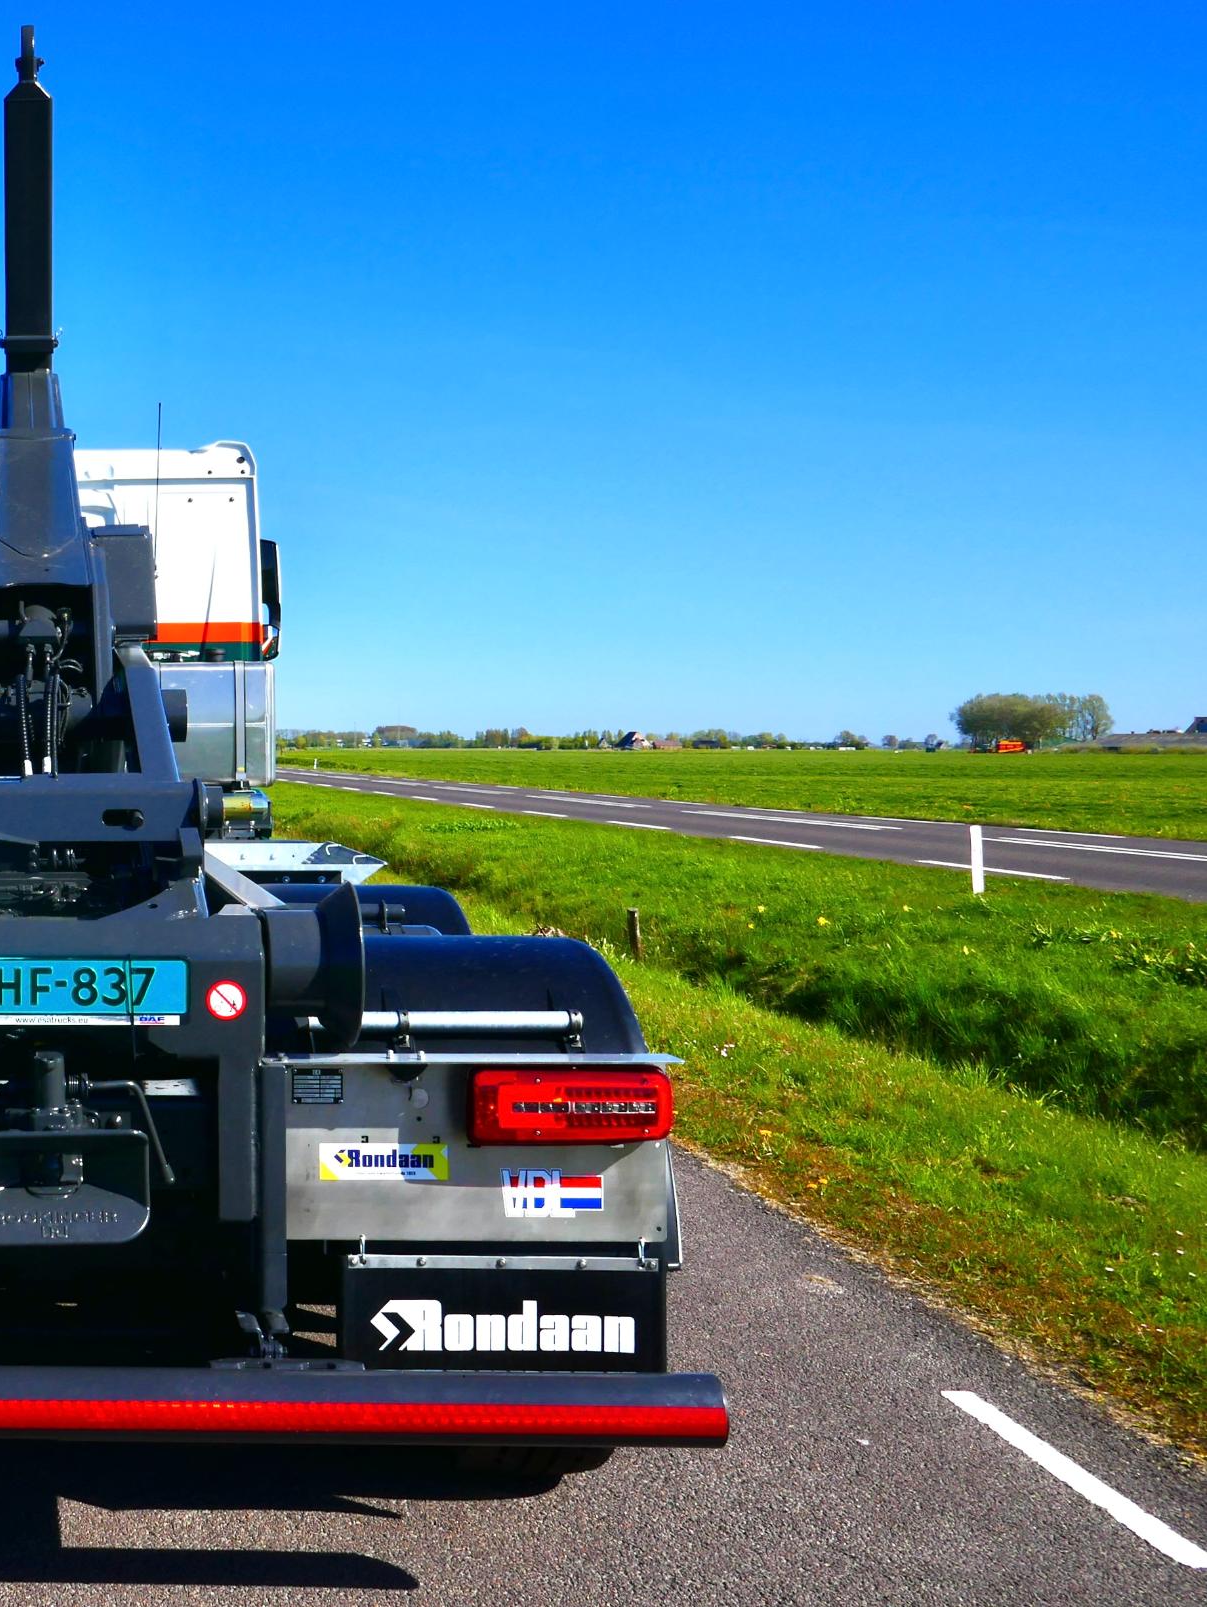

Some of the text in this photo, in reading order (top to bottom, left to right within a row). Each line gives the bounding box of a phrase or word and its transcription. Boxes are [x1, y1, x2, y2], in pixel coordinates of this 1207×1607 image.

[347, 1149, 434, 1168] Rondaan
[500, 1168, 576, 1218] VDL
[370, 1299, 635, 1353] Rondaan
